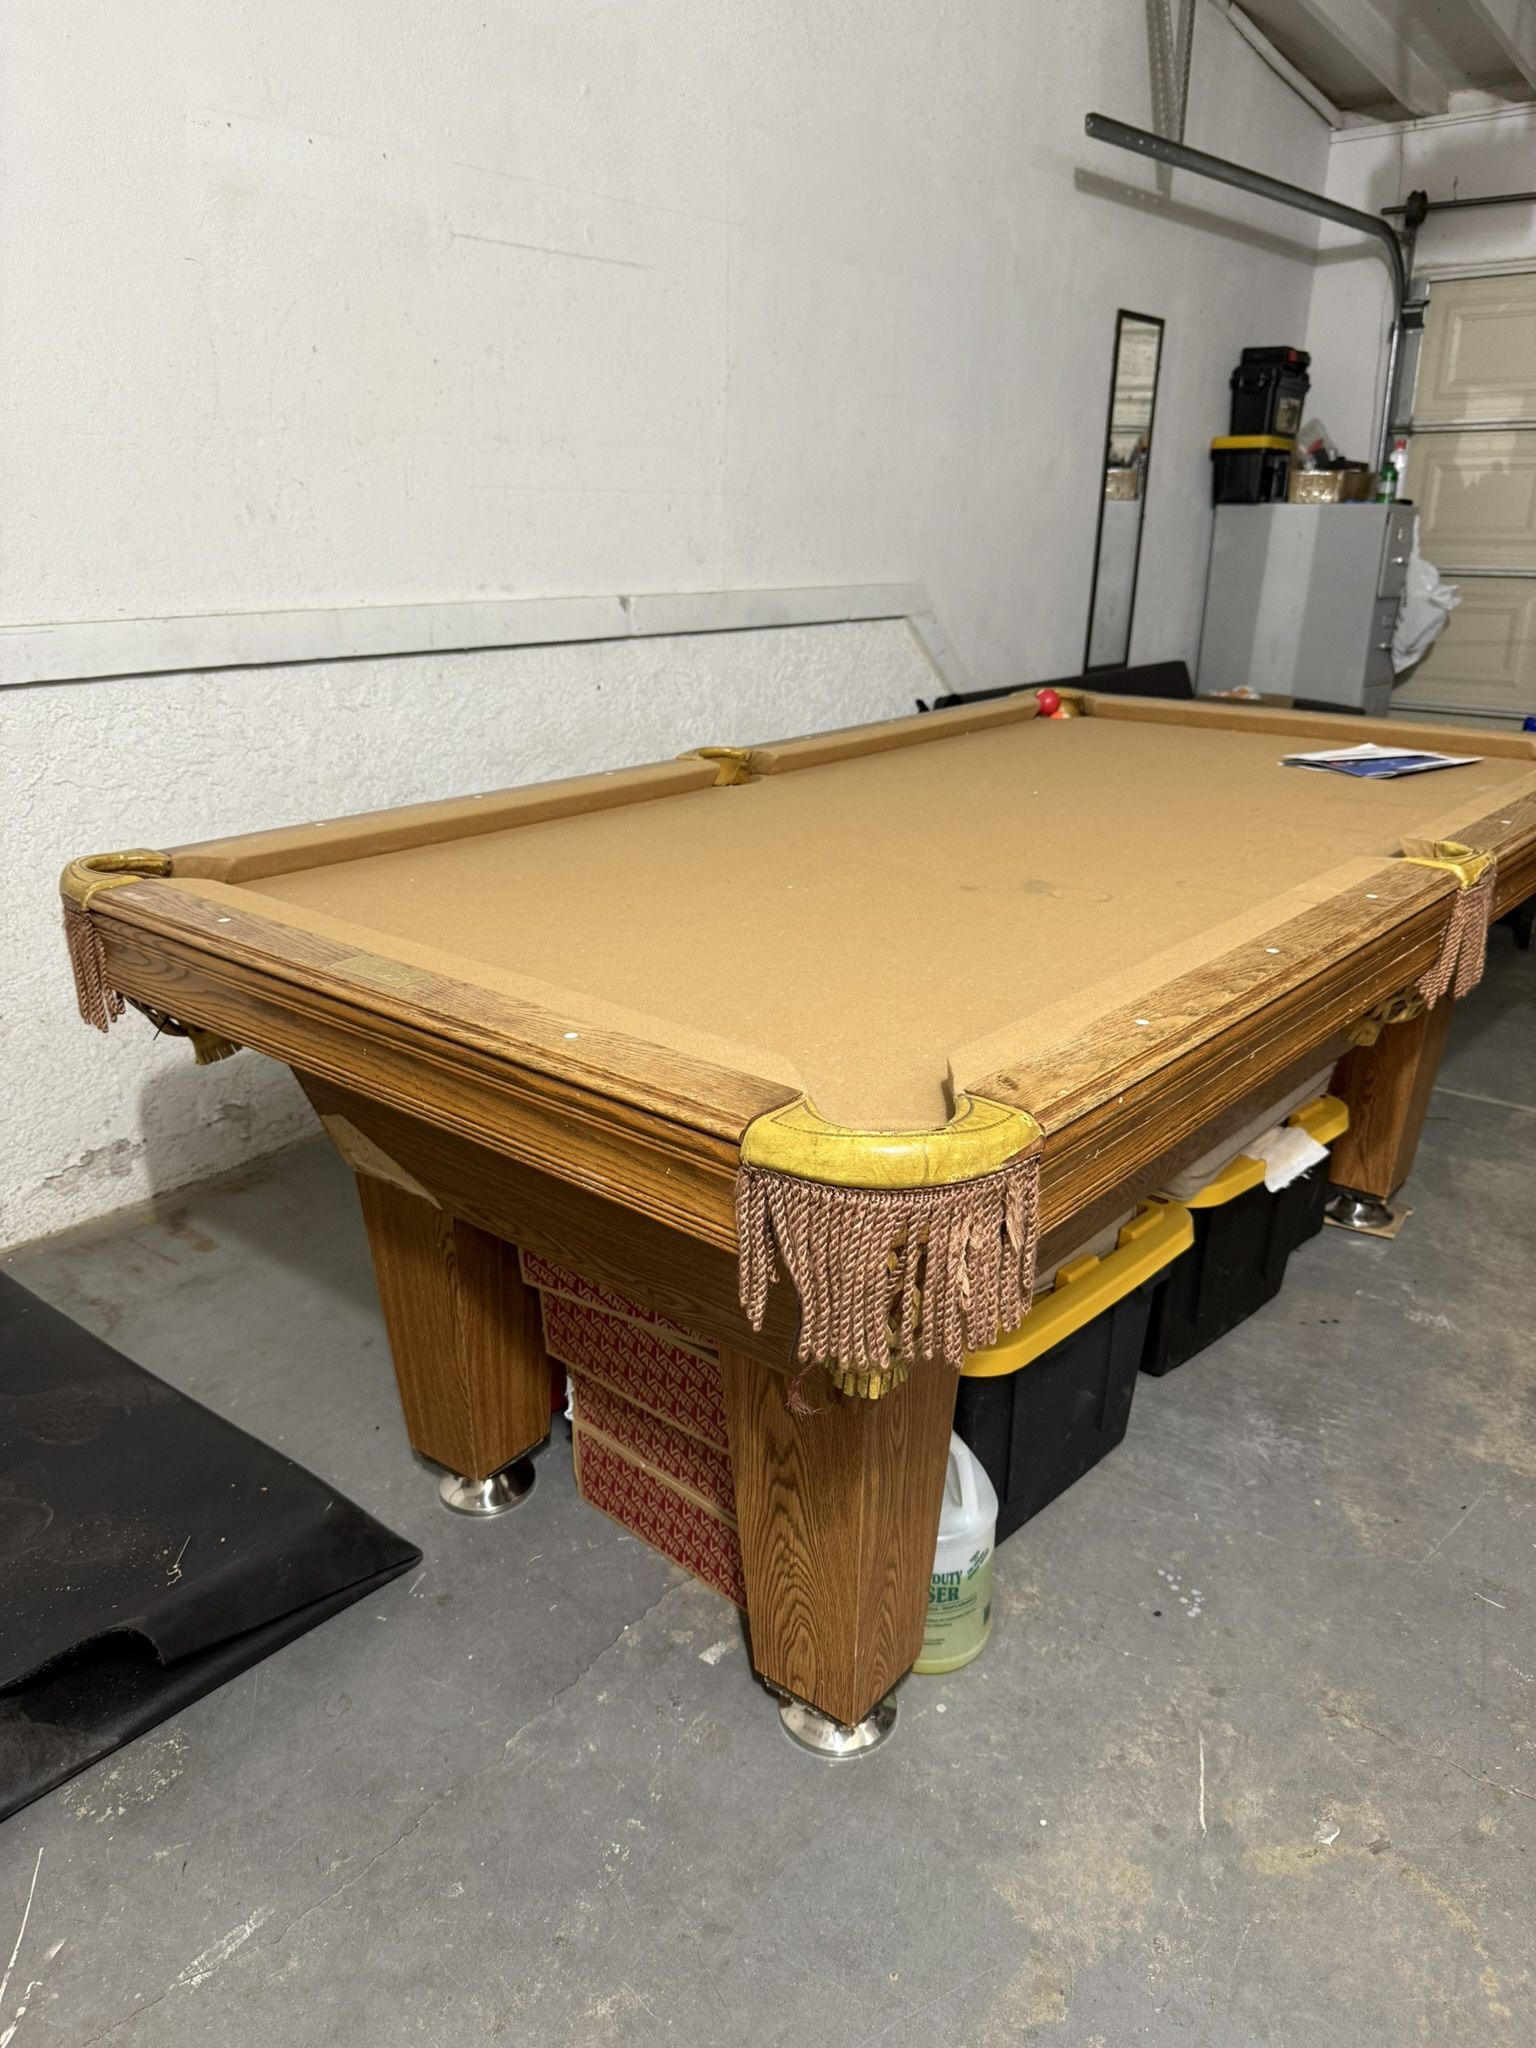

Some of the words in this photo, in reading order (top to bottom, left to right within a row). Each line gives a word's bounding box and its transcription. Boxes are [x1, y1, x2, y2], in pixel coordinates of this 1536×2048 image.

[526, 1253, 557, 1287] VANS
[566, 1330, 593, 1365] VANS
[573, 1307, 601, 1343] VANS
[600, 1336, 628, 1373] VANS
[628, 1365, 657, 1403] VANS
[582, 1333, 610, 1369] VANS
[590, 1310, 617, 1345] VANS
[618, 1340, 646, 1377] VANS
[646, 1369, 674, 1408] VANS
[655, 1346, 684, 1384] VANS
[685, 1377, 716, 1417] VANS
[675, 1350, 706, 1389] VANS
[636, 1343, 666, 1381] VANS
[666, 1373, 695, 1412] VANS
[696, 1406, 728, 1444] VANS
[652, 1433, 681, 1472] VANS
[670, 1439, 698, 1479] VANS
[688, 1443, 717, 1483] VANS
[589, 1453, 615, 1488] VANS
[614, 1481, 641, 1519] VANS
[598, 1477, 624, 1513] VANS
[606, 1457, 632, 1494] VANS
[631, 1487, 658, 1524] VANS
[656, 1519, 683, 1557] VANS
[622, 1462, 648, 1498] VANS
[647, 1492, 675, 1529] VANS
[673, 1525, 700, 1564] VANS
[638, 1467, 666, 1504] VANS
[665, 1499, 693, 1536] VANS
[691, 1532, 720, 1571] VANS
[718, 1566, 747, 1605] VANS
[682, 1503, 711, 1542] VANS
[709, 1537, 738, 1577] VANS
[700, 1511, 730, 1550] VANS
[928, 1586, 959, 1603] SER
[932, 1570, 963, 1585] DUTY
